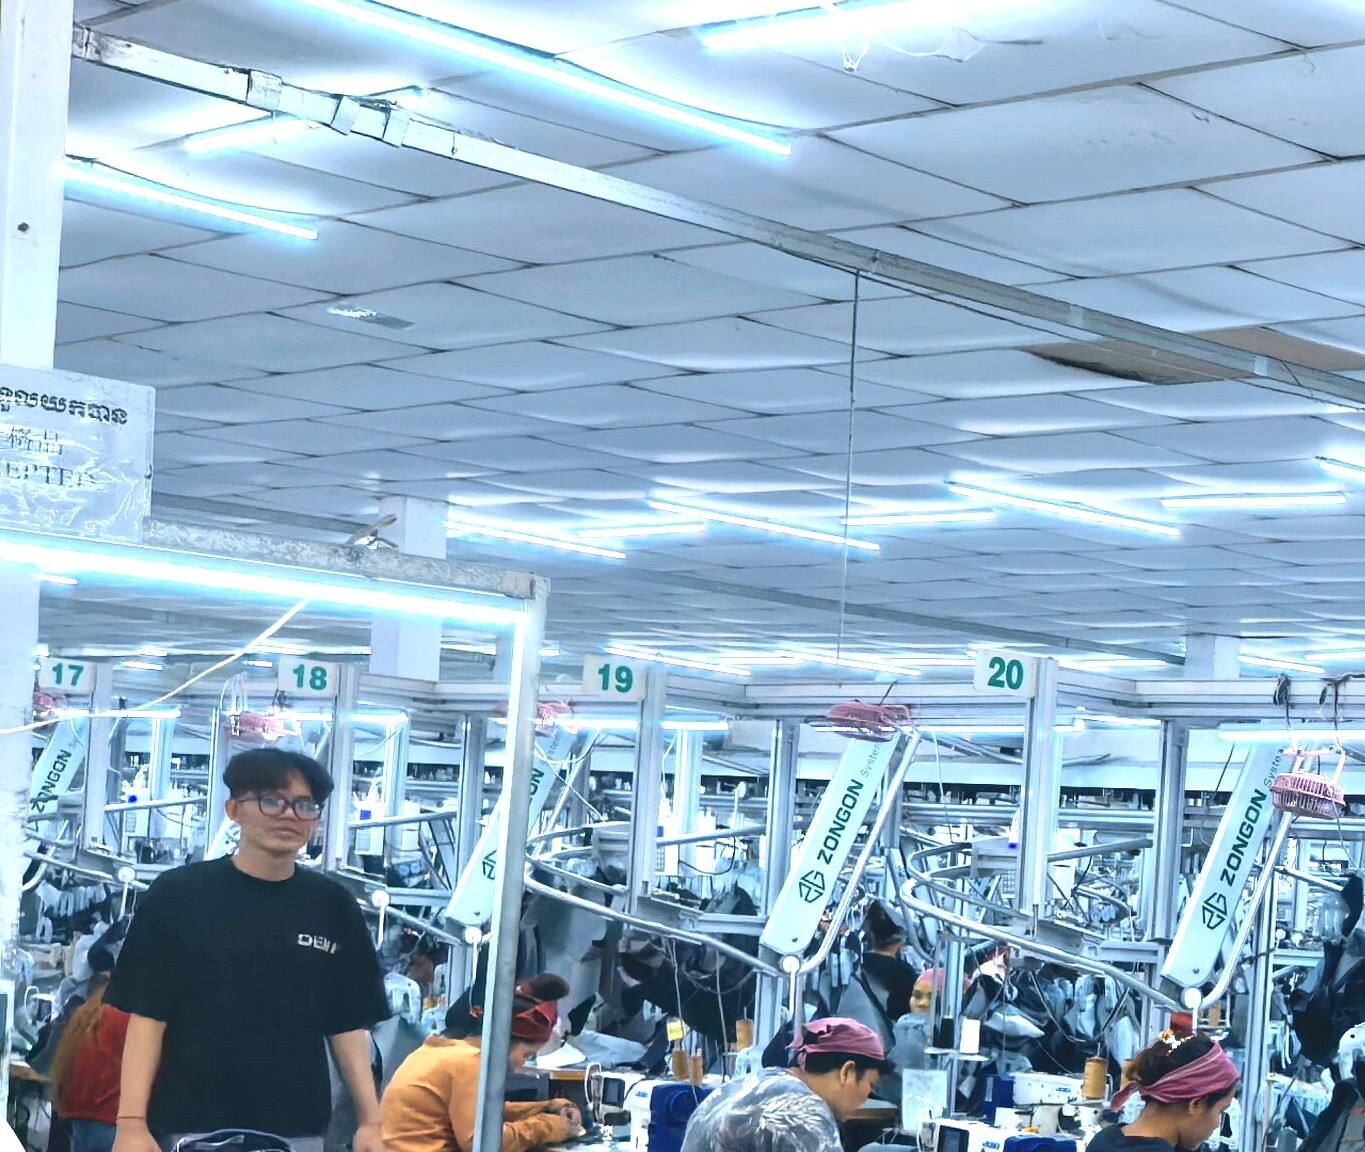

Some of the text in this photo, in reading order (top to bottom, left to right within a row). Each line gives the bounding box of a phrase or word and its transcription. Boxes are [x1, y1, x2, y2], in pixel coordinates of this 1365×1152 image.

[52, 663, 84, 687] 17
[292, 665, 327, 691] 18
[598, 664, 633, 692] 19
[988, 656, 1024, 690] 20
[817, 778, 864, 865] ZONGON
[1220, 755, 1283, 887] ZONGON Syste
